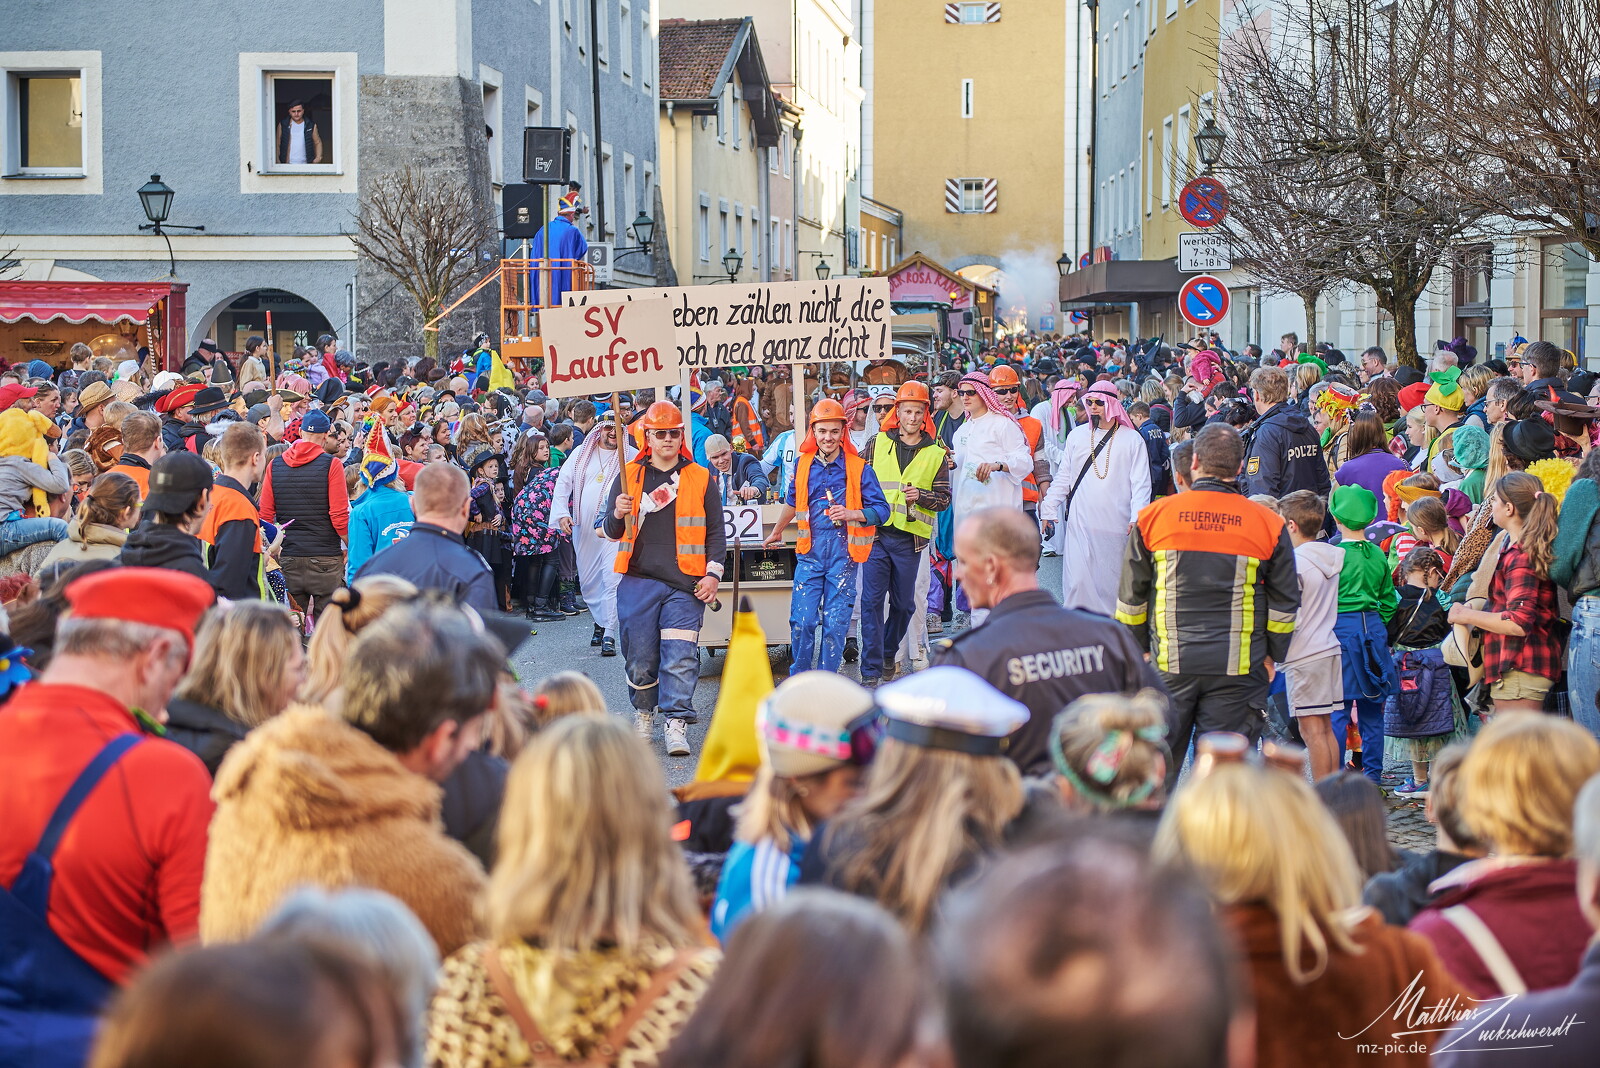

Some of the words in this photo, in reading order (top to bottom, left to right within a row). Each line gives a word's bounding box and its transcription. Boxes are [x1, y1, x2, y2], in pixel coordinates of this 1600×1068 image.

[1183, 238, 1226, 247] werktags
[906, 272, 932, 284] ROSA
[1189, 259, 1215, 268] 16-18
[1216, 259, 1222, 267] h
[584, 305, 625, 338] SV
[726, 288, 792, 326] zählen
[798, 284, 848, 328] nicht,
[850, 285, 885, 322] die
[715, 328, 757, 365] ned
[766, 336, 812, 365] ganz
[818, 325, 870, 360] dicht
[878, 323, 887, 358] !
[548, 336, 664, 384] Laufen
[722, 508, 759, 539] 32
[1178, 511, 1242, 527] FEUERWEHR
[1194, 522, 1225, 532] LAUFEN
[1007, 644, 1105, 686] SECURITY
